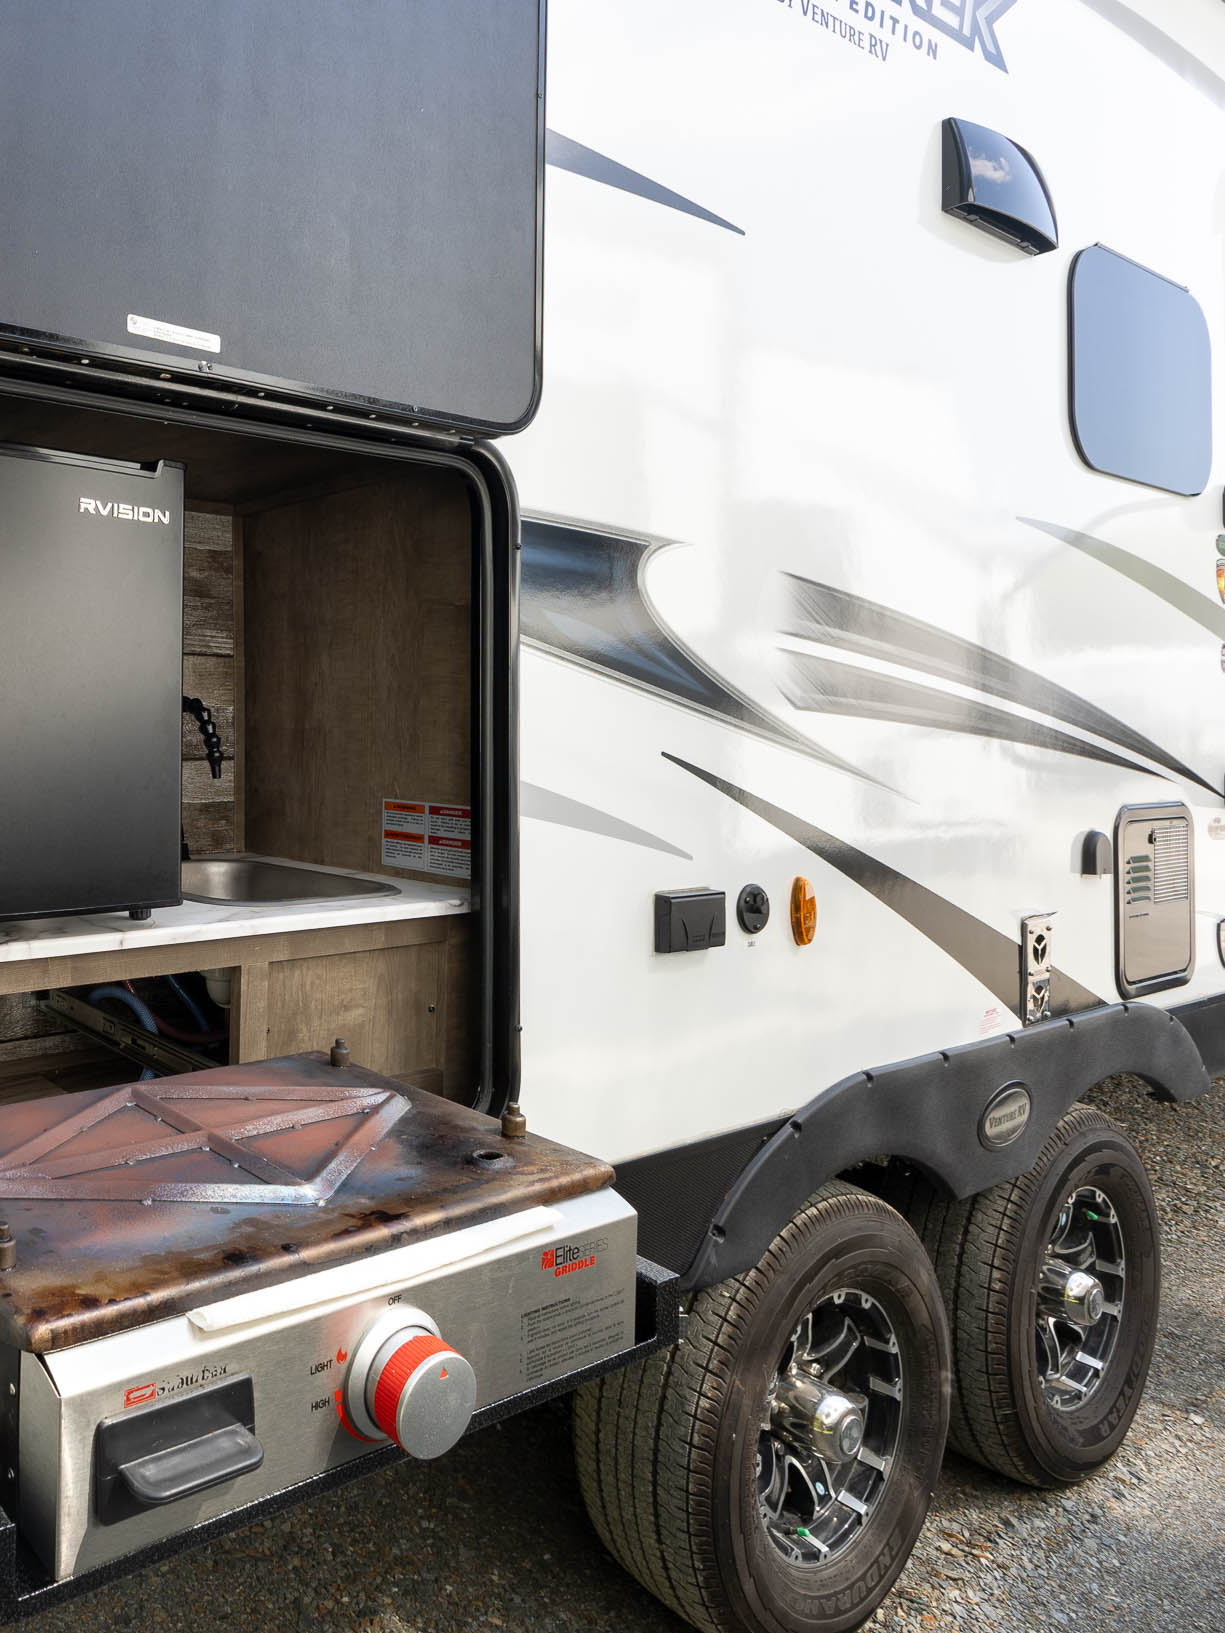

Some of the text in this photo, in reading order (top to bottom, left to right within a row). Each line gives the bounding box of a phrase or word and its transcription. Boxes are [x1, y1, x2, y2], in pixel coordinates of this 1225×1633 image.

[800, 0, 890, 62] VENTURE RV
[78, 496, 171, 525] RVISION
[989, 1108, 1018, 1129] VENTURE
[554, 1255, 596, 1278] GRIDDLE
[387, 1294, 402, 1306] OFF
[309, 1359, 333, 1376] LIGHT
[311, 1396, 330, 1413] HIGH
